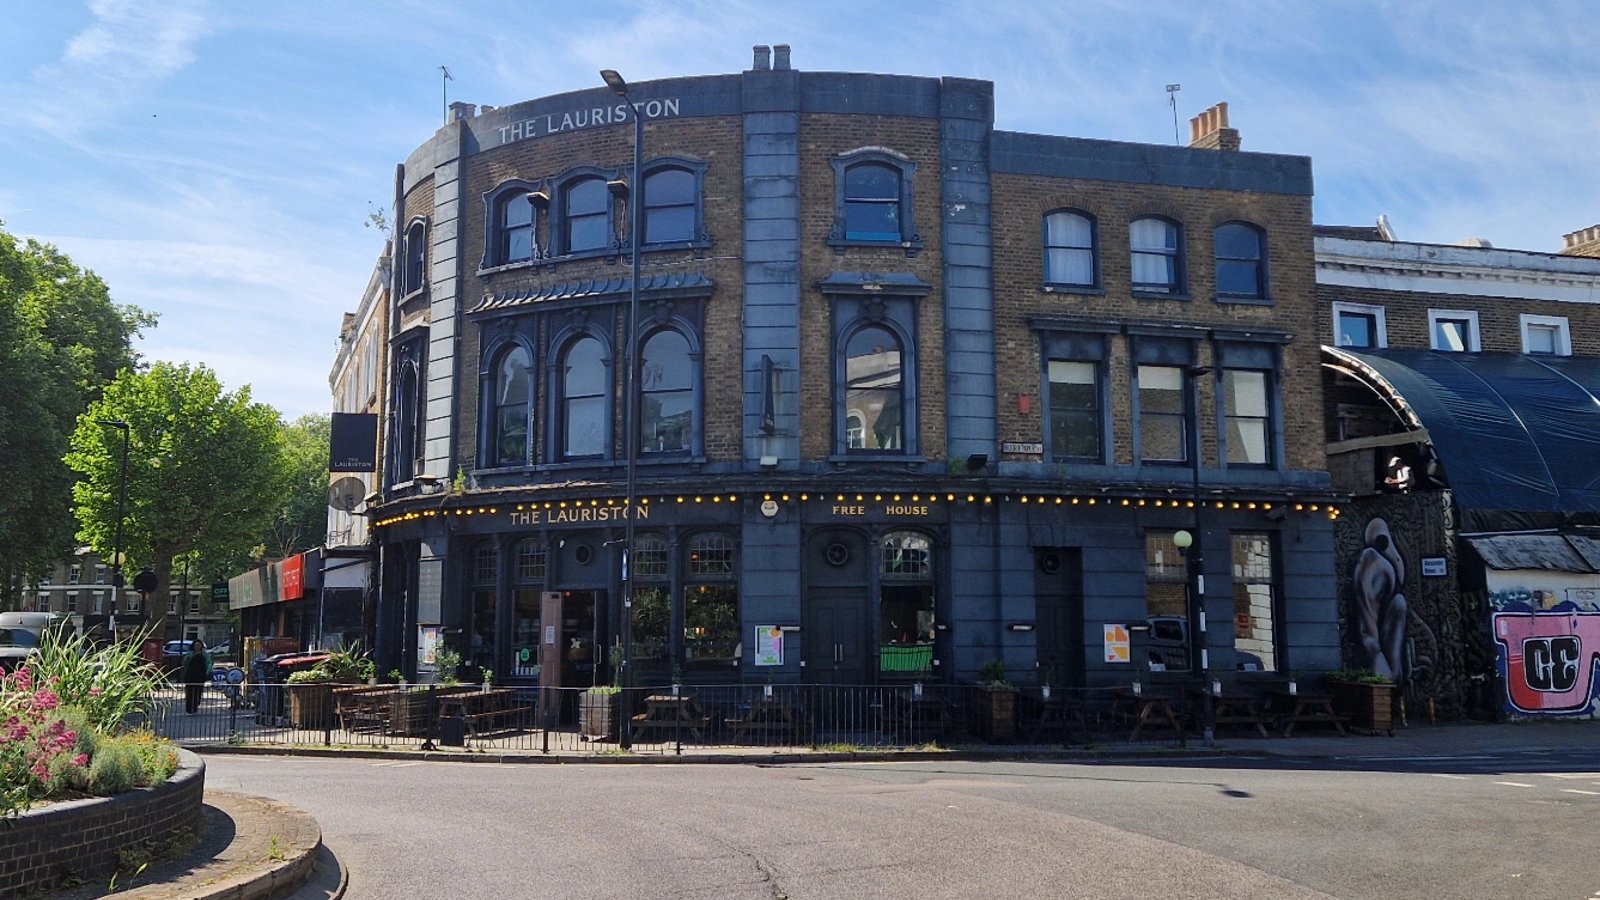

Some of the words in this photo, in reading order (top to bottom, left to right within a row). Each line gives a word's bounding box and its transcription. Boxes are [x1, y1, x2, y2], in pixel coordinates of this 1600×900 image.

[498, 119, 536, 144] THE
[547, 98, 680, 133] LAURISTON
[832, 506, 865, 515] FREE
[886, 506, 928, 515] HOUSE
[510, 512, 540, 526] THE
